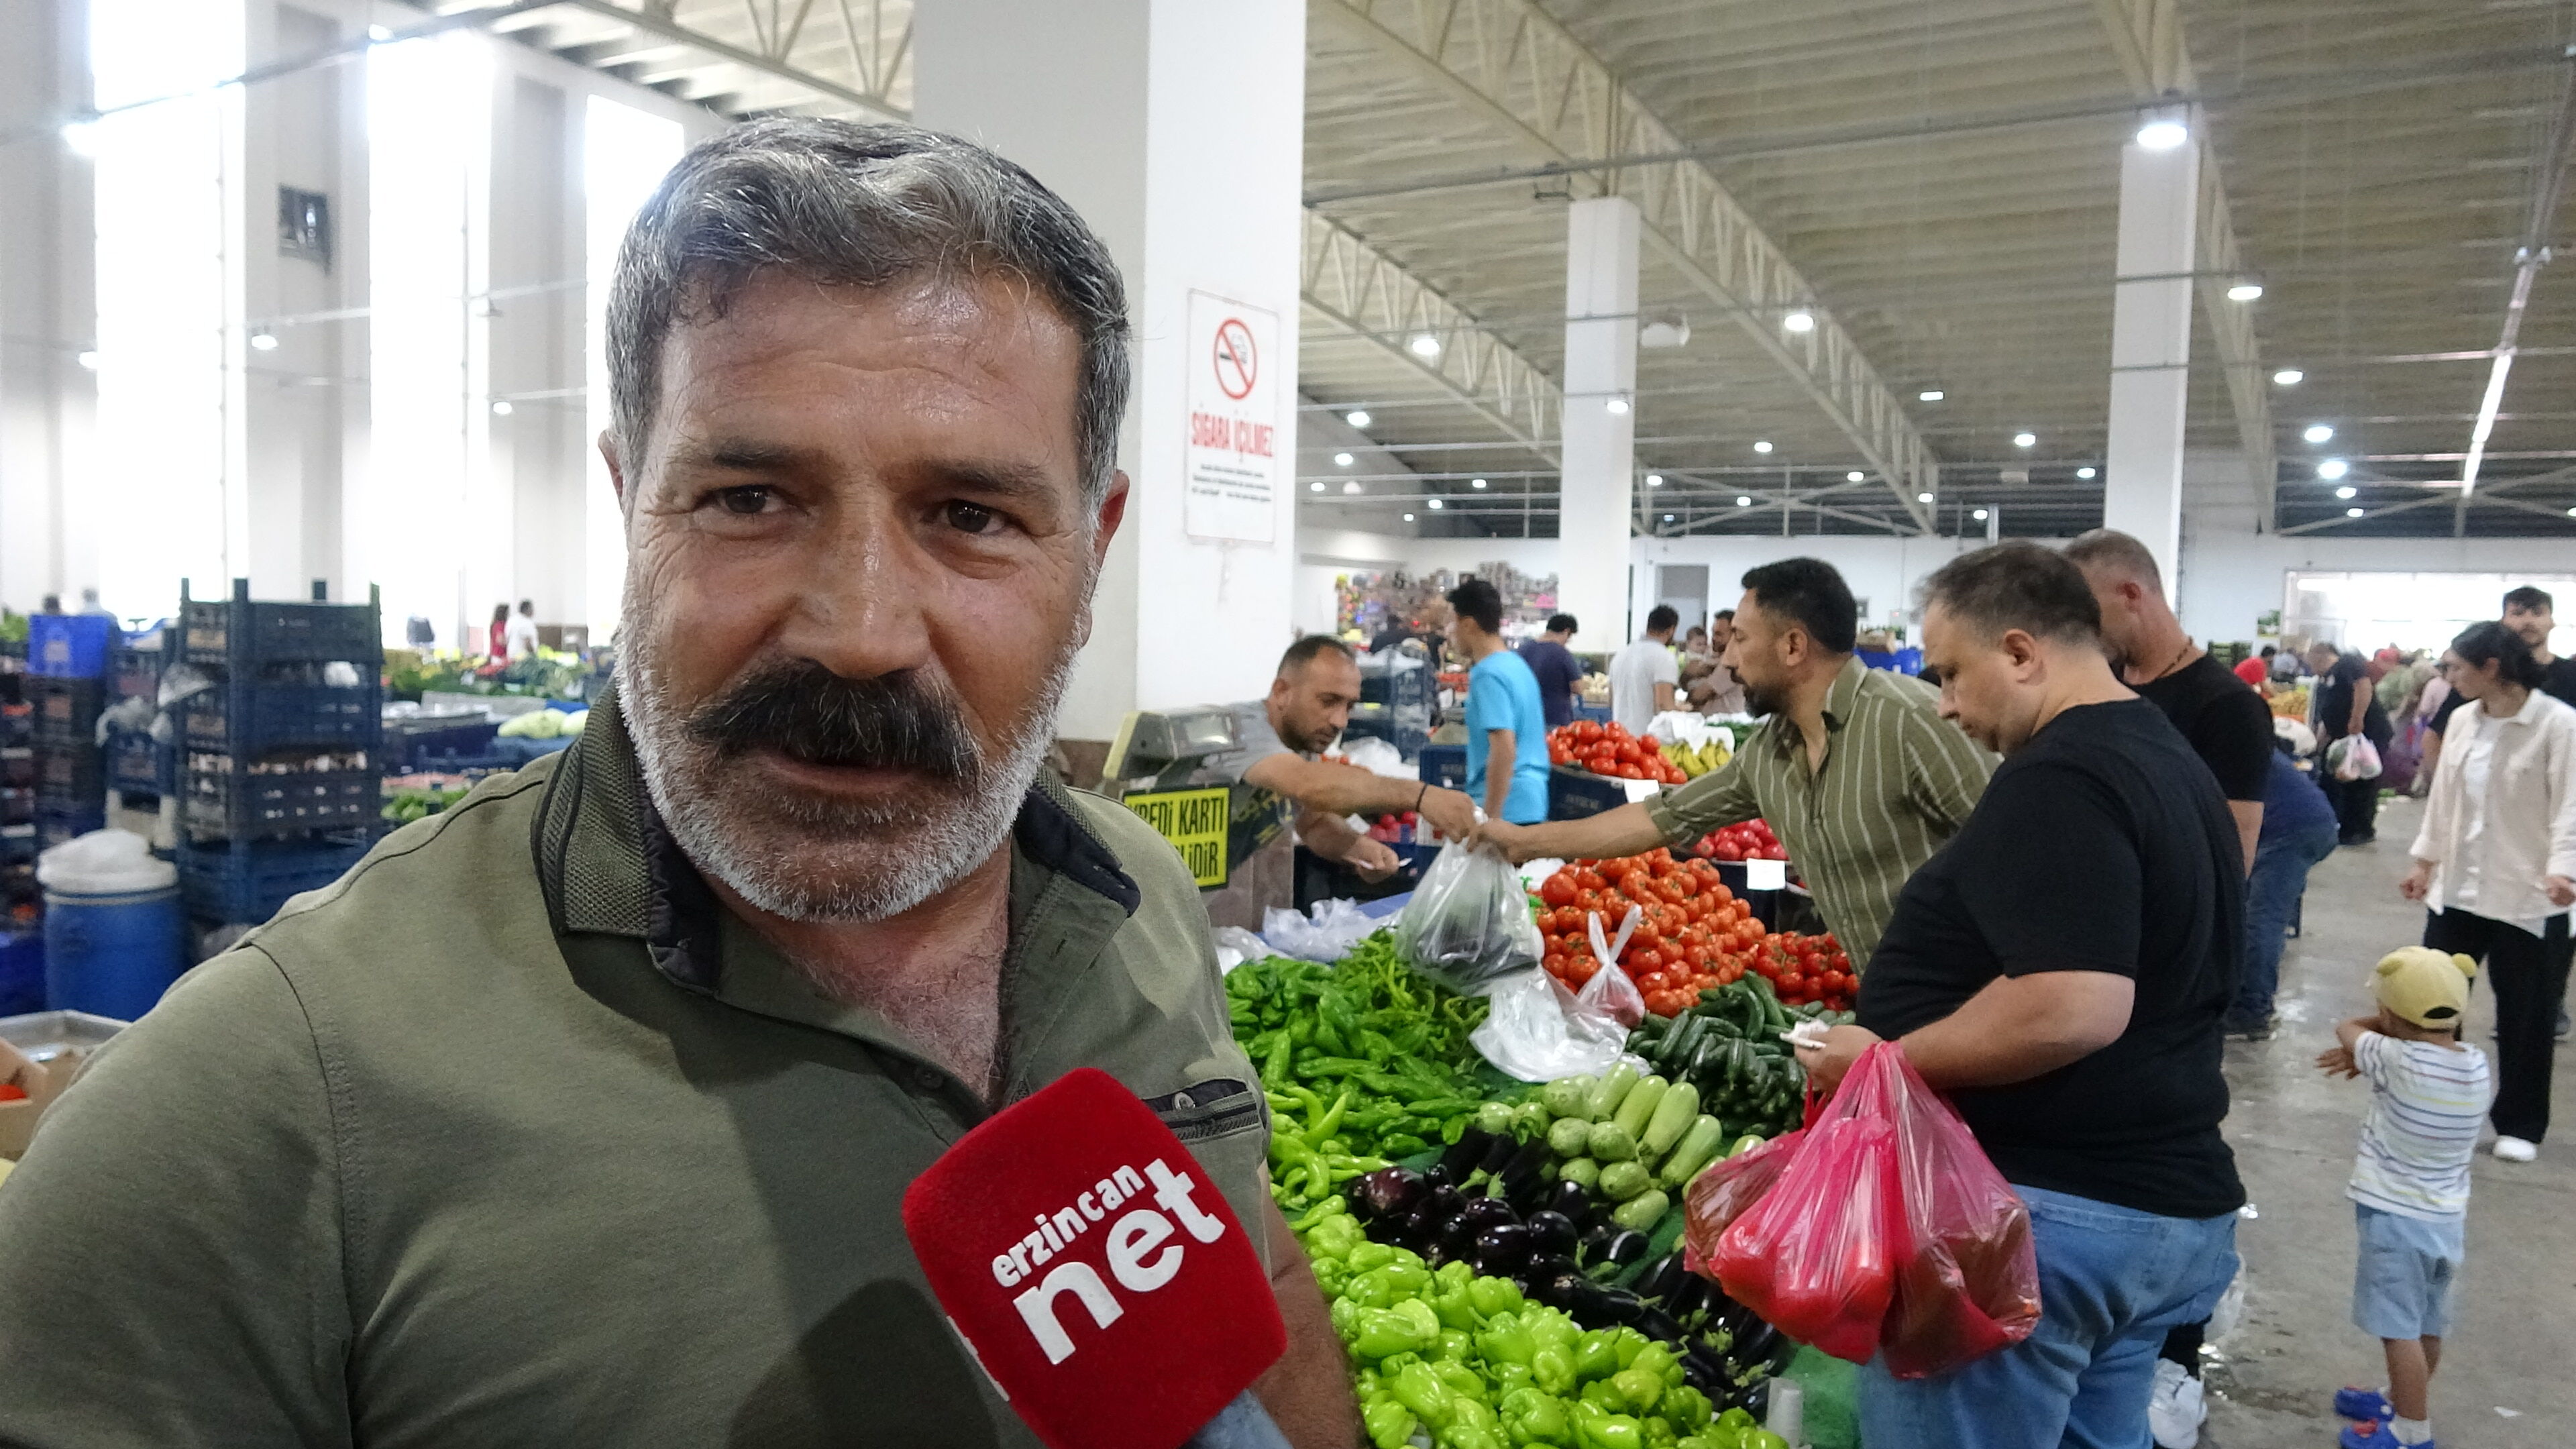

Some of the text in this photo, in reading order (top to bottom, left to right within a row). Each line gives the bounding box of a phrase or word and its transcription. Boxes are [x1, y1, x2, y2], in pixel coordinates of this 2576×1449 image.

[1178, 796, 1225, 836] KARTI
[991, 1165, 1145, 1287] erzincan
[1013, 1158, 1226, 1365] net
